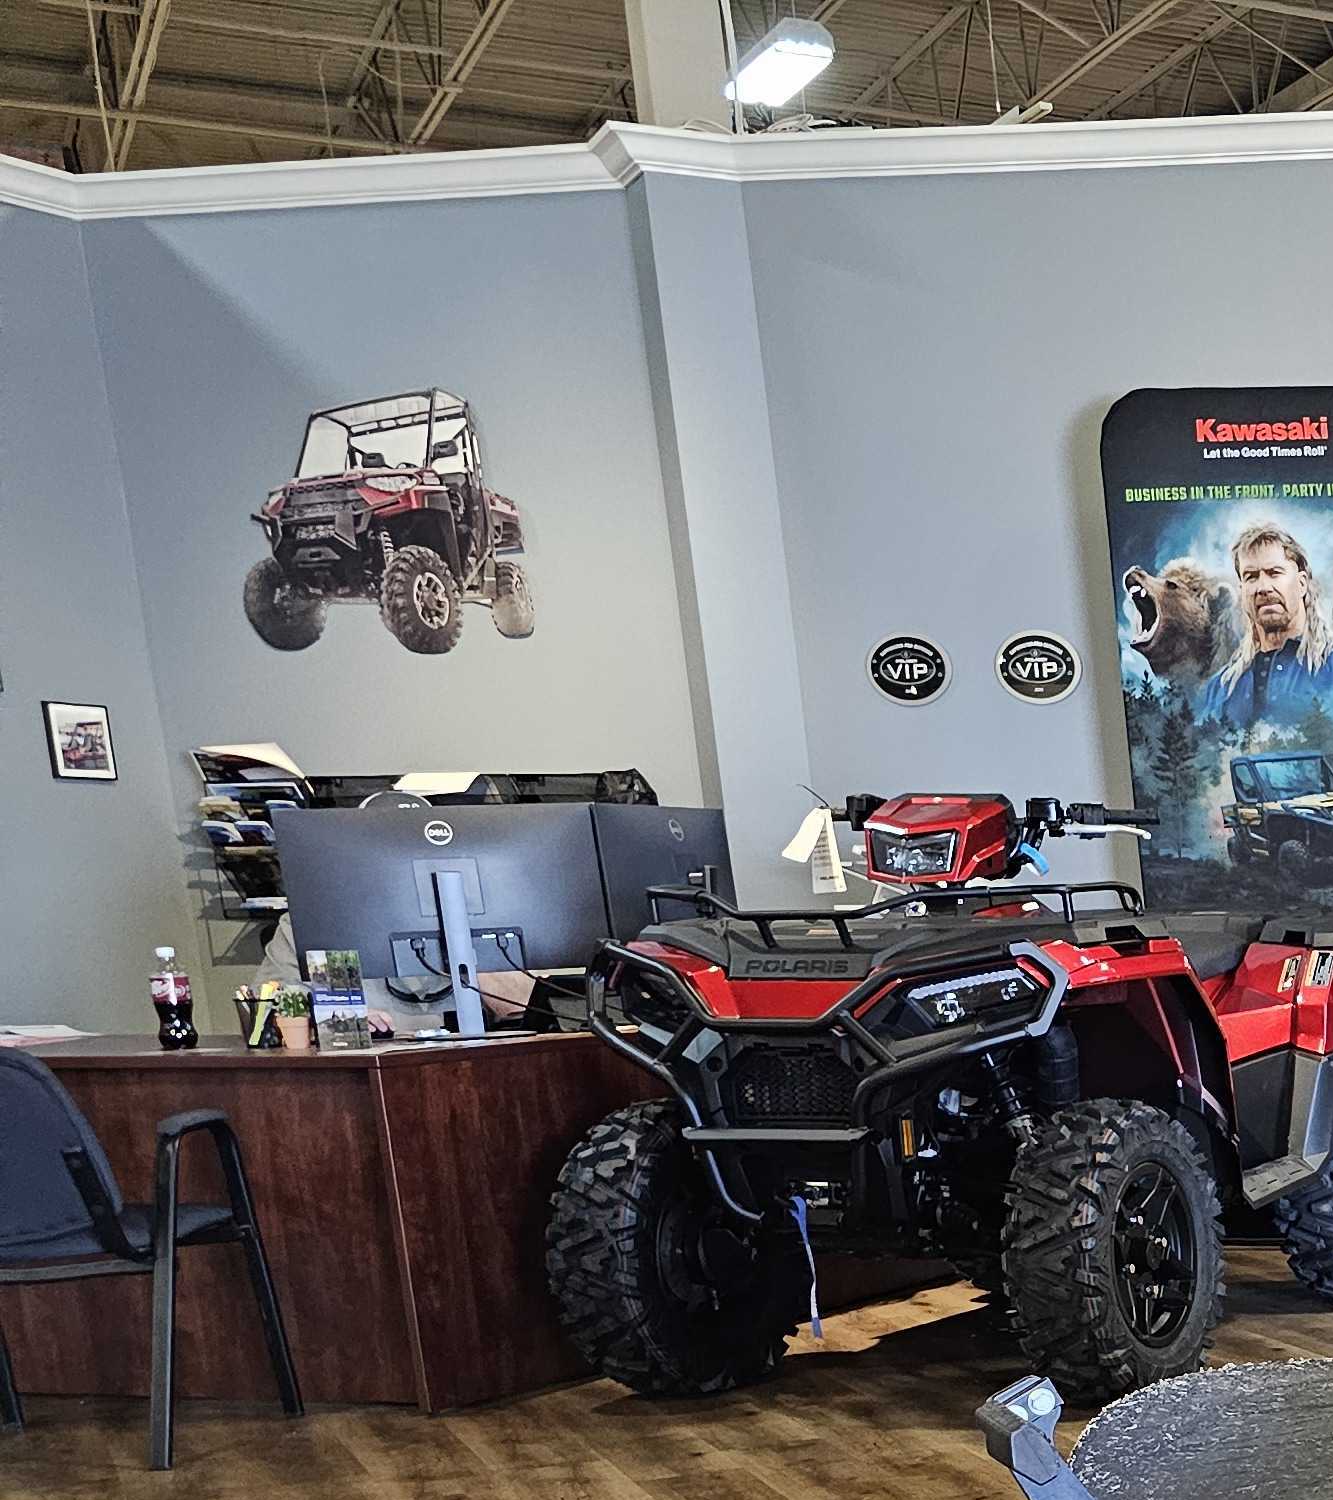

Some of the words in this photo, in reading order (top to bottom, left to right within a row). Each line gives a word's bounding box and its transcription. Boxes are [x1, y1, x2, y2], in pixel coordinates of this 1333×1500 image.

[1196, 417, 1328, 442] Kawasaki
[1203, 448, 1221, 458] Let
[1222, 447, 1240, 457] the
[1241, 446, 1269, 457] Good
[1271, 446, 1302, 456] Times
[1125, 486, 1187, 502] BUSINESS
[1190, 486, 1204, 499] IN
[1206, 485, 1231, 499] THE
[1283, 483, 1323, 497] PARTY
[887, 663, 928, 679] VIP
[1016, 662, 1058, 678] VIP
[428, 828, 450, 838] DELL
[745, 959, 849, 975] POLARIS
